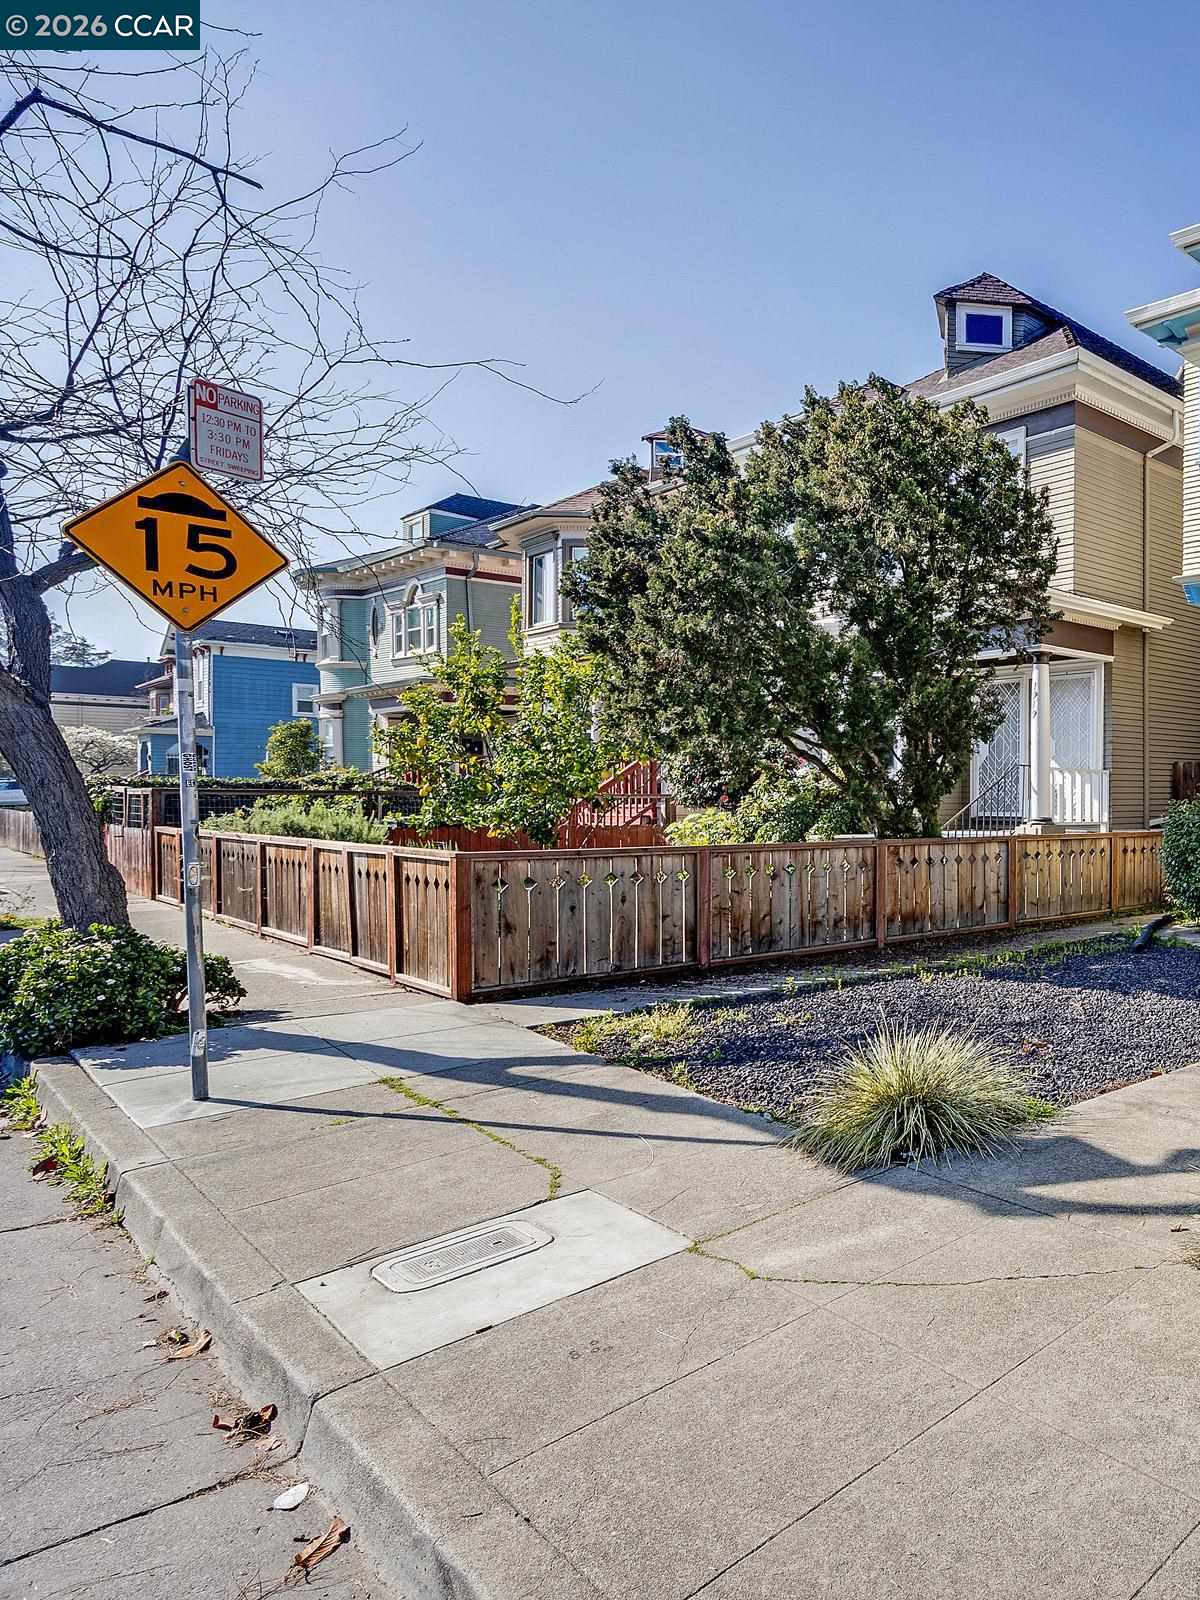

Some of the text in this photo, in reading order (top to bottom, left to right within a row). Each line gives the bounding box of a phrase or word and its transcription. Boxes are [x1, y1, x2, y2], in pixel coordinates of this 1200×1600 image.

[195, 383, 260, 415] NO PARKING
[202, 412, 257, 437] 12:30 PM TO
[207, 429, 250, 449] 3:30 PM
[210, 445, 249, 463] FRIDAYS
[135, 516, 238, 580] 15
[152, 579, 218, 603] MPH
